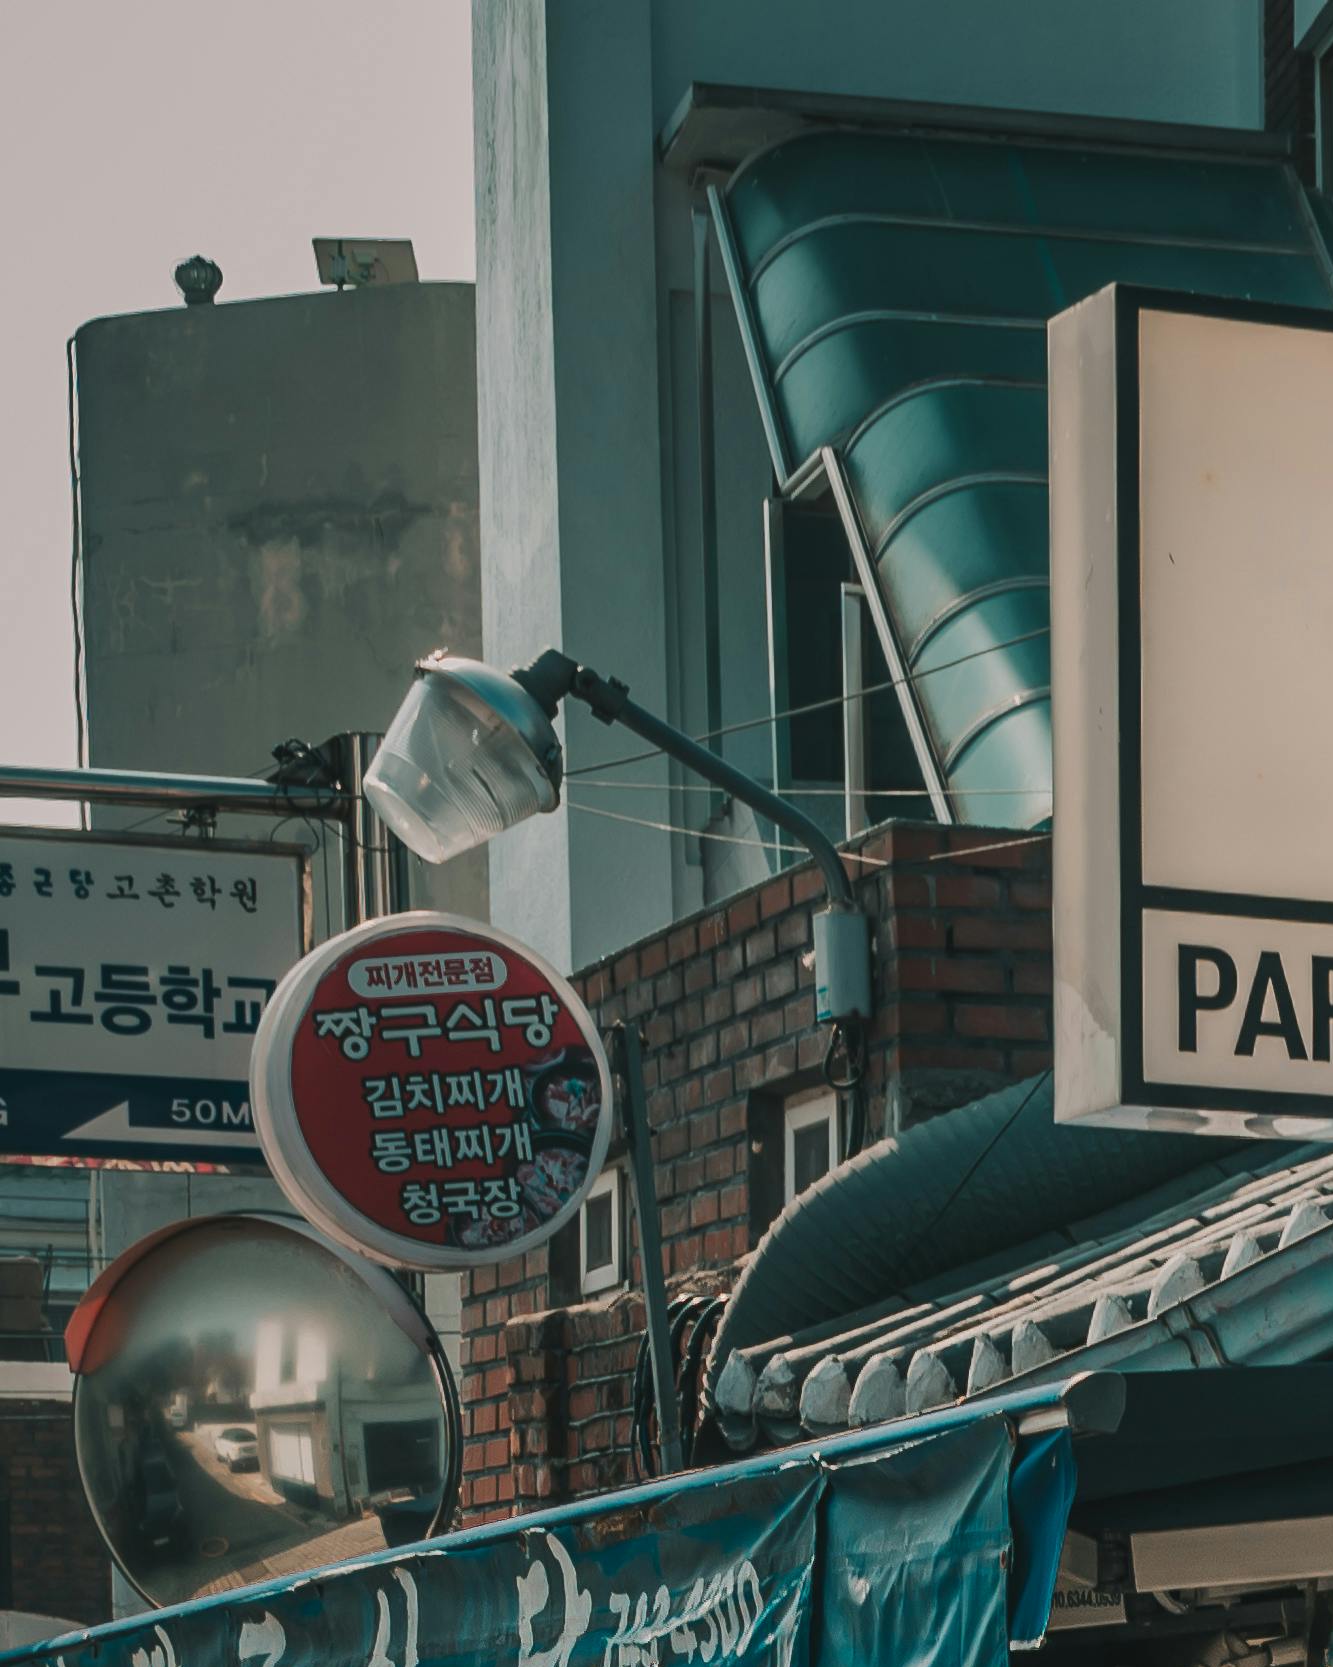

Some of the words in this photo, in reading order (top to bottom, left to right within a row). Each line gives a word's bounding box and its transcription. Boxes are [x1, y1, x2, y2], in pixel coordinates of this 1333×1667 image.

[364, 955, 496, 990] 찌개전문점
[313, 993, 560, 1062] 짱구식당
[171, 1098, 250, 1125] 50M
[362, 1067, 527, 1120] 김치찌개
[371, 1120, 534, 1174] 동태찌개
[400, 1176, 523, 1226] 청국장
